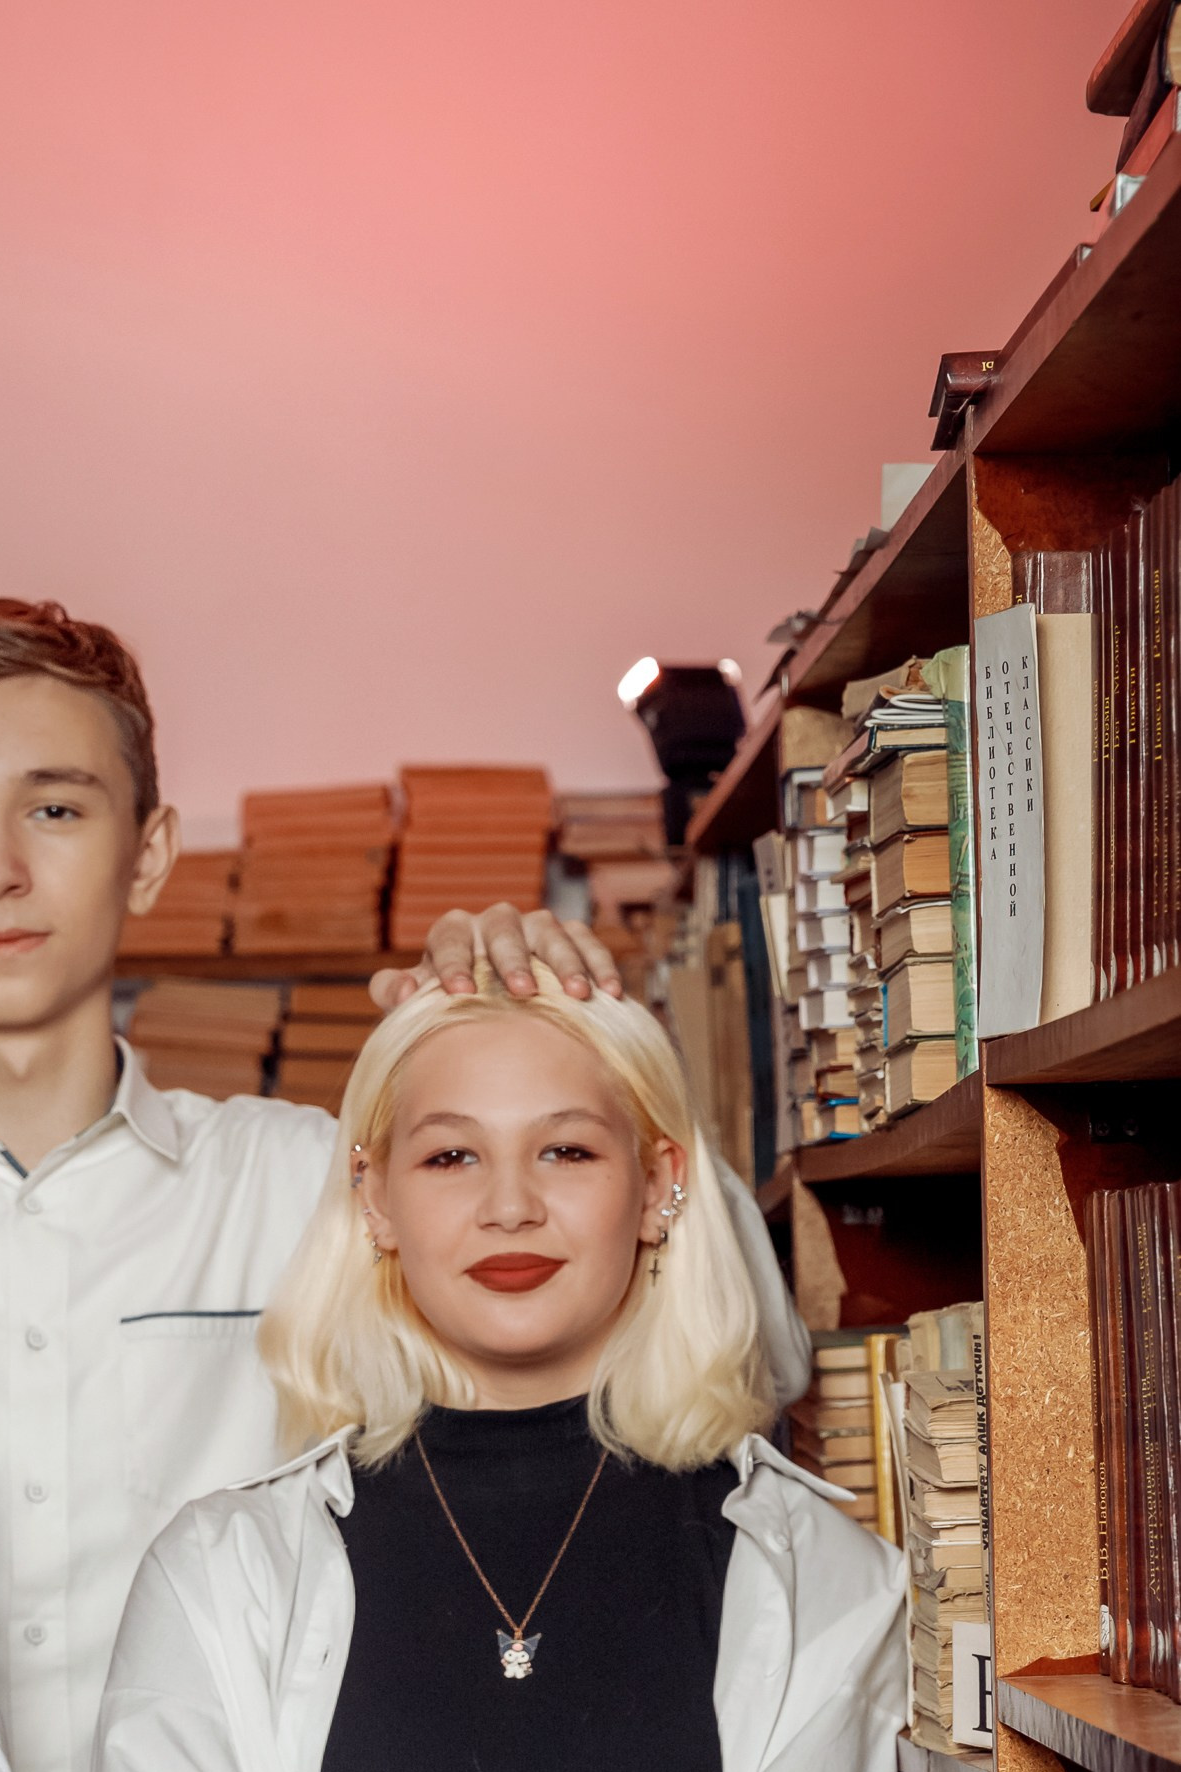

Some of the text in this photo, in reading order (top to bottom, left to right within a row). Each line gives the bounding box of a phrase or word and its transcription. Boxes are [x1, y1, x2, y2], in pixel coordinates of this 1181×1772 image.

[1129, 667, 1137, 744] Повести
[985, 656, 1034, 917] БИБЛИОТЕКА ОТЕЧЕСТВЕННОЙ КЛАССИКИ
[1097, 1461, 1108, 1535] Набоков
